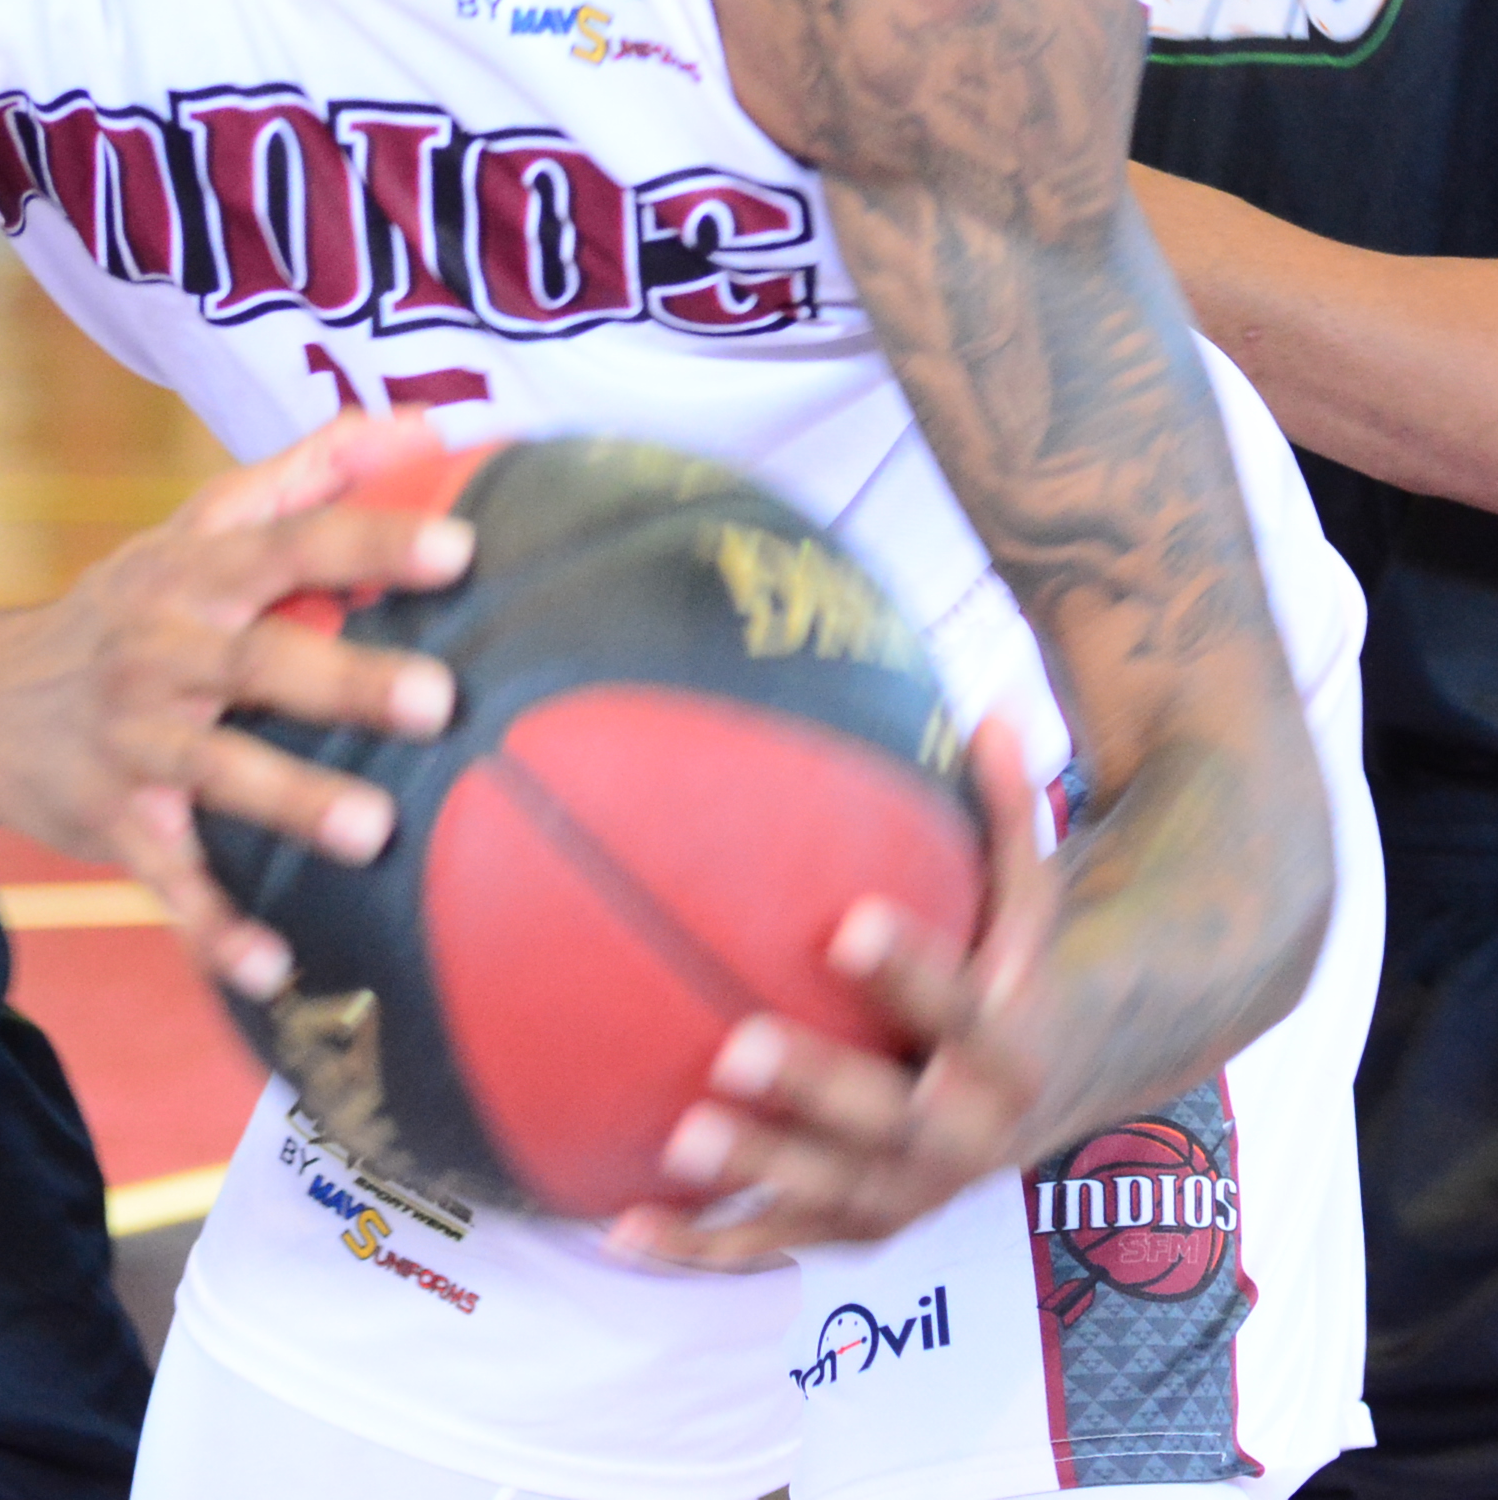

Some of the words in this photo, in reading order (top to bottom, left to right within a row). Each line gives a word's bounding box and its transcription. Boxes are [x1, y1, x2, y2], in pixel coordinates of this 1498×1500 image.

[279, 1135, 322, 1177] BY
[1032, 1173, 1239, 1235] INDIOS
[1118, 1232, 1201, 1264] SFM
